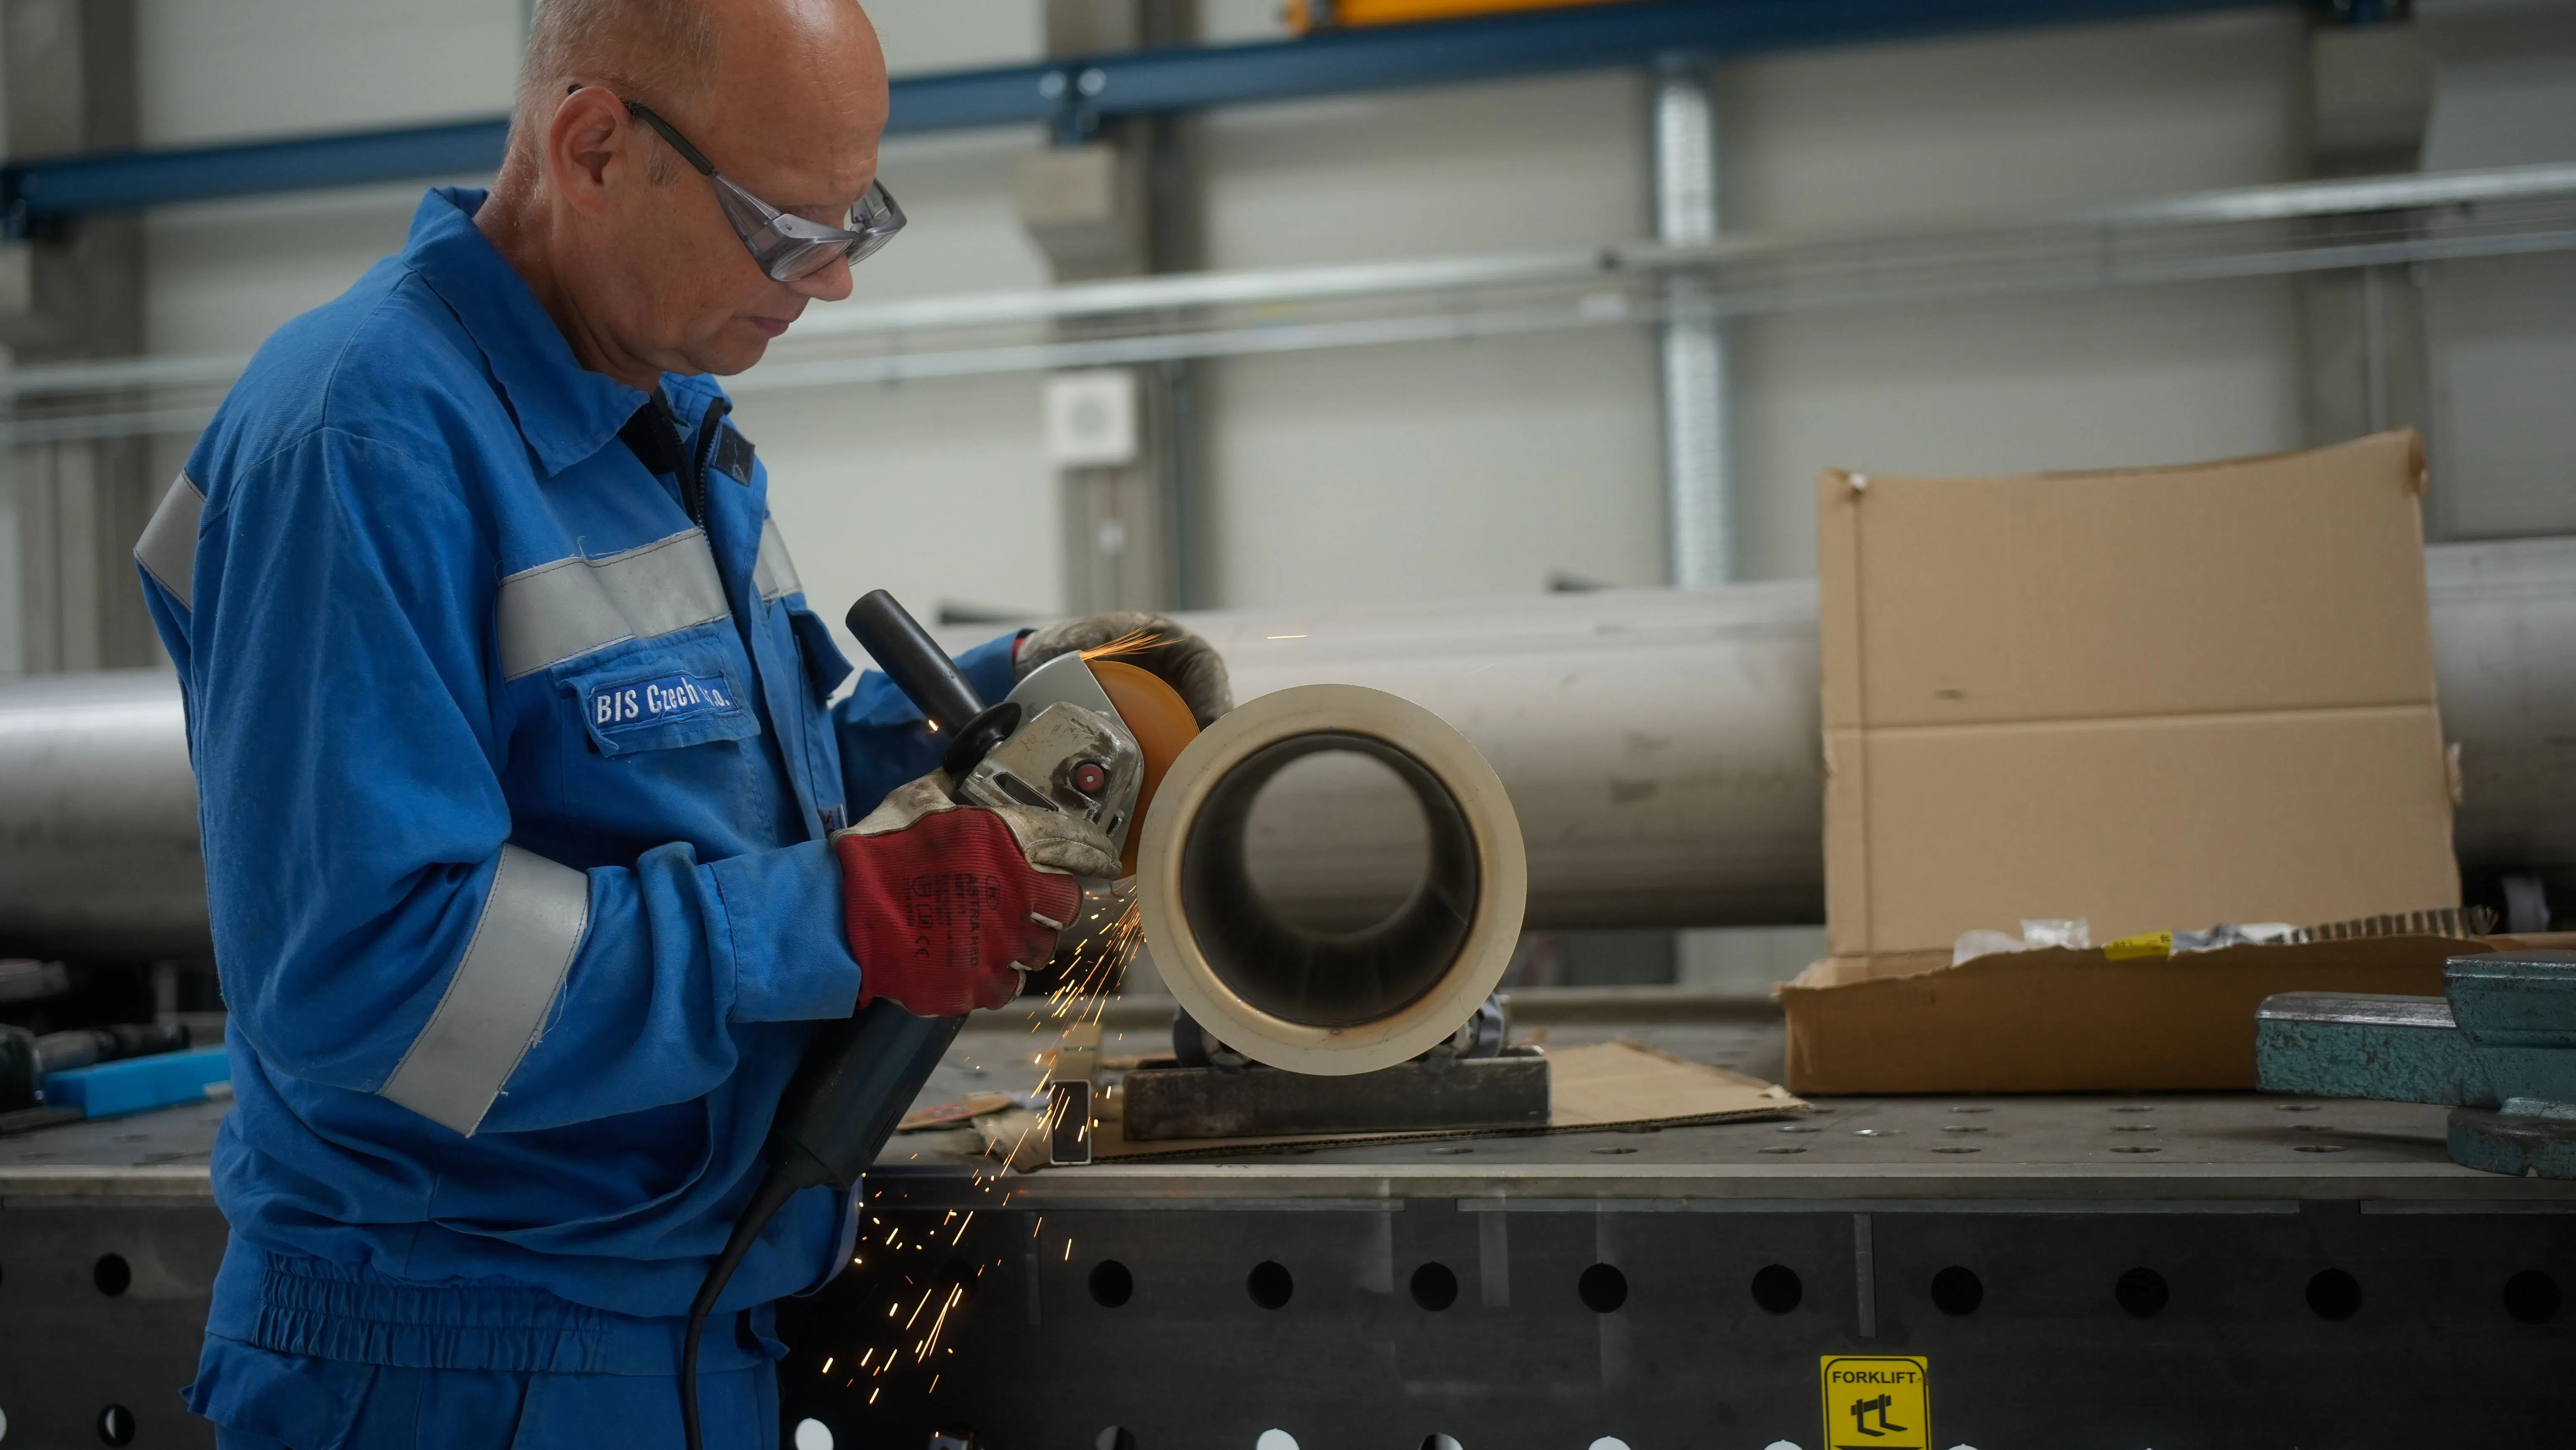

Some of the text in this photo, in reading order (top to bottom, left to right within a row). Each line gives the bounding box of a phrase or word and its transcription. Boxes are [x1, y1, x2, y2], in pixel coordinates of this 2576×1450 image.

[597, 677, 730, 724] BIS Czech r.o.
[1832, 1371, 1916, 1384] FORKLIFT
